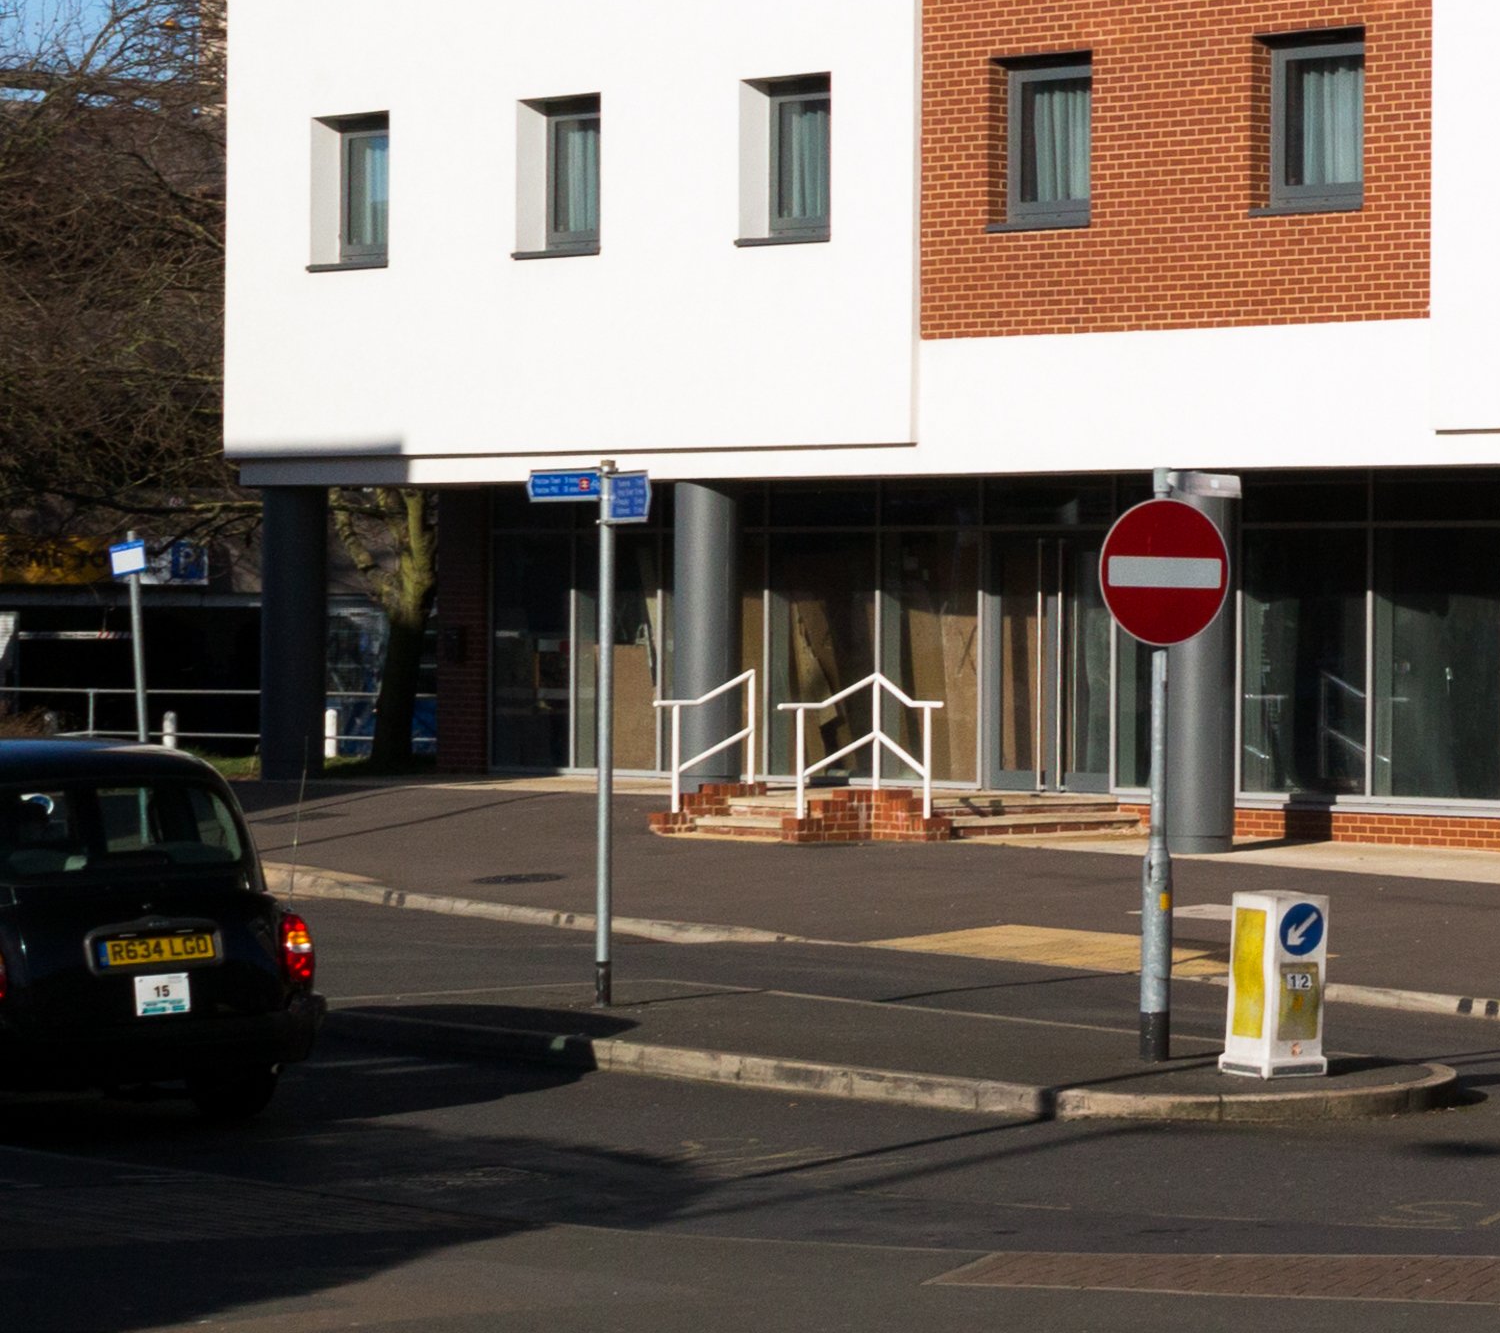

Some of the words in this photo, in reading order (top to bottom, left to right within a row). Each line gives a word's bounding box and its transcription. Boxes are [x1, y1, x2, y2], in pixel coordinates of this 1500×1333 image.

[110, 940, 164, 962] R634
[1290, 974, 1310, 989] 12
[153, 984, 171, 998] 15
